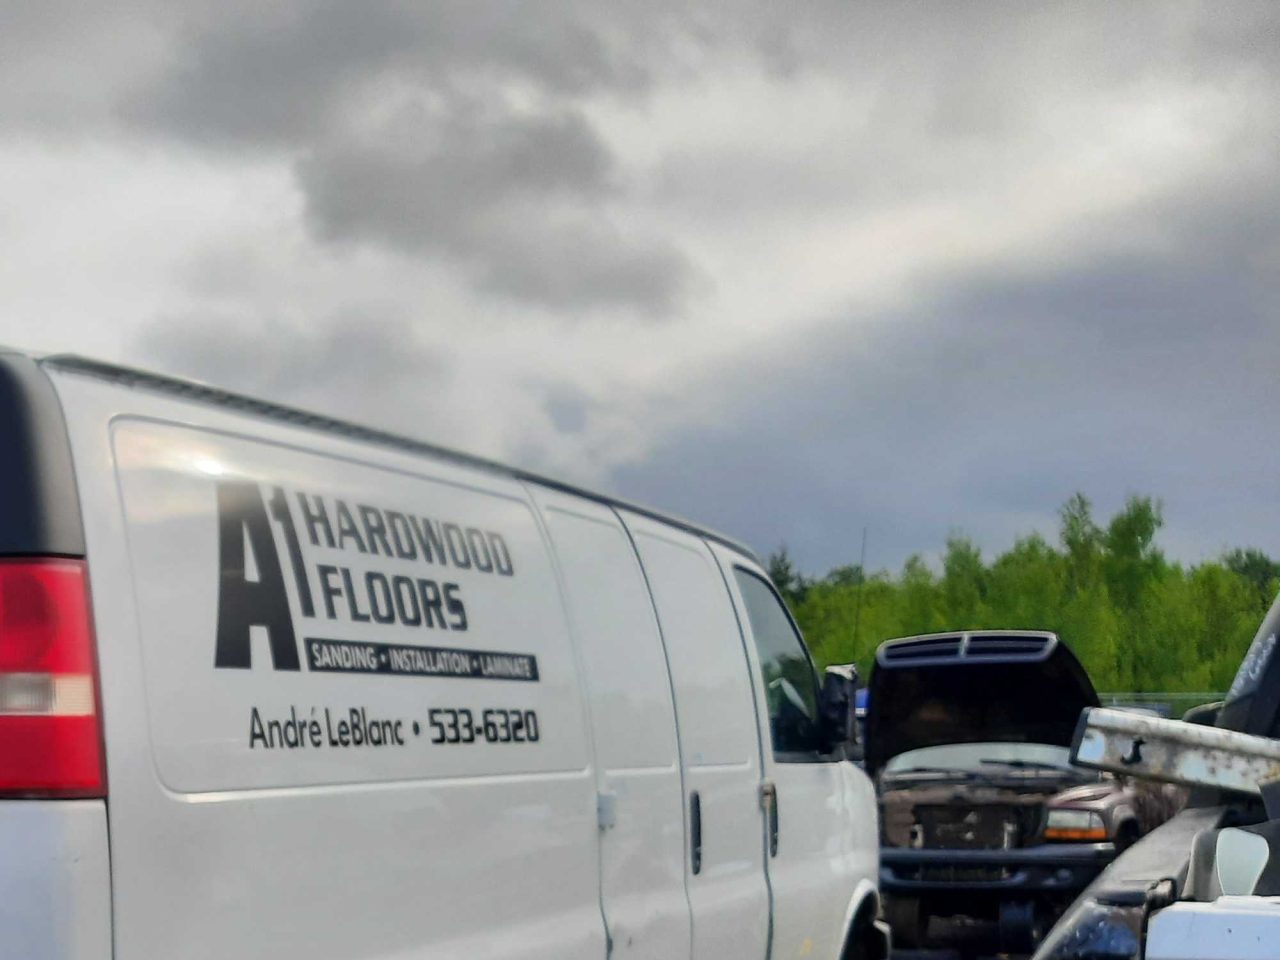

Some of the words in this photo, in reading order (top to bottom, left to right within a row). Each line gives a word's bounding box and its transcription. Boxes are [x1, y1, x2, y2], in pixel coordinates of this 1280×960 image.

[295, 492, 514, 577] HARDWOOD
[214, 480, 316, 672] A1
[317, 563, 468, 632] FLOORS
[312, 642, 377, 670] SANDING
[389, 650, 470, 674] INSTALLATION
[480, 656, 532, 678] LAMINATE
[249, 705, 321, 749] André
[325, 706, 405, 747] LeBlanc
[428, 708, 539, 745] 533-6320
